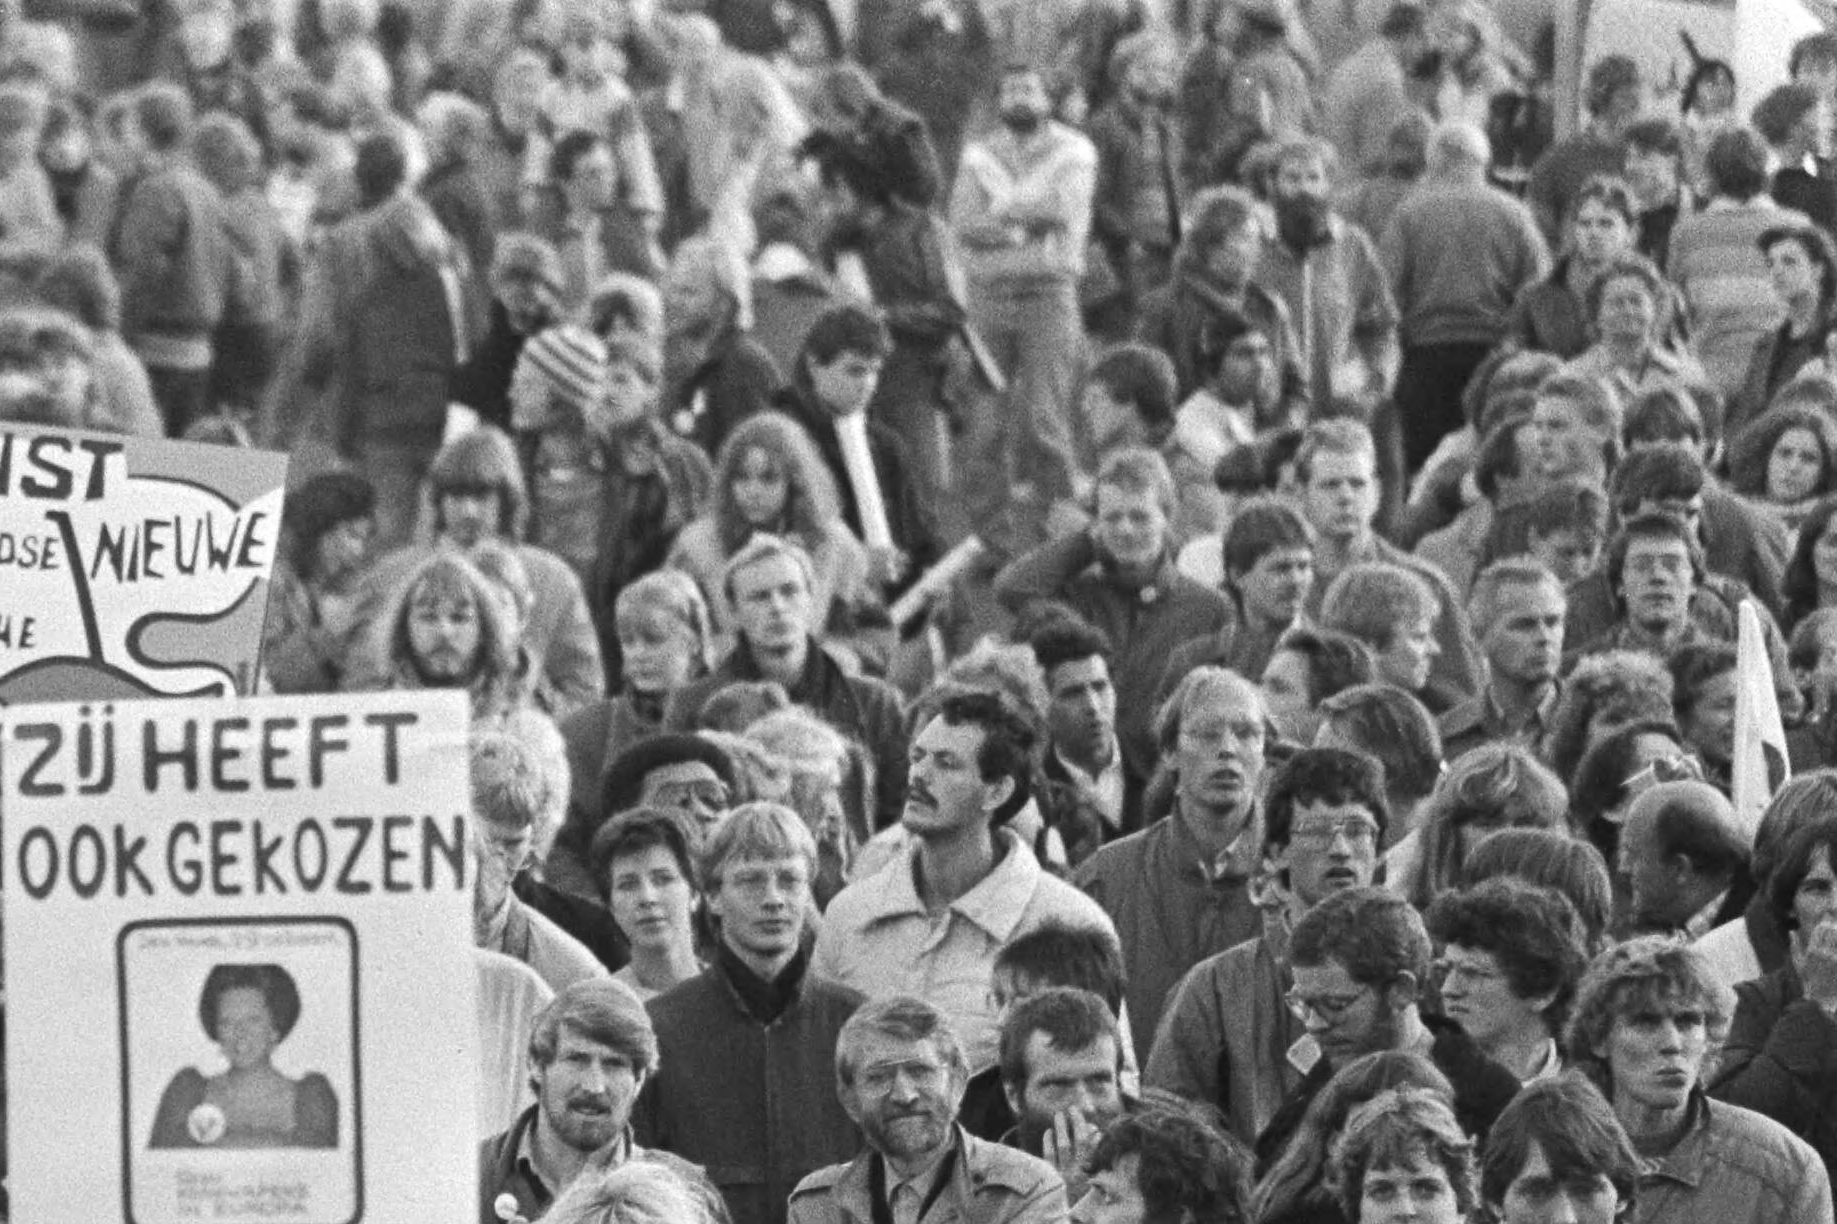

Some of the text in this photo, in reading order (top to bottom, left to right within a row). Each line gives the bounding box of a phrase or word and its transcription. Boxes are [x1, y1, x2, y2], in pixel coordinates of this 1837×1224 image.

[92, 510, 268, 582] NIEUWE
[142, 713, 417, 792] HEEFT
[17, 816, 467, 899] OOK GEKOZEN
